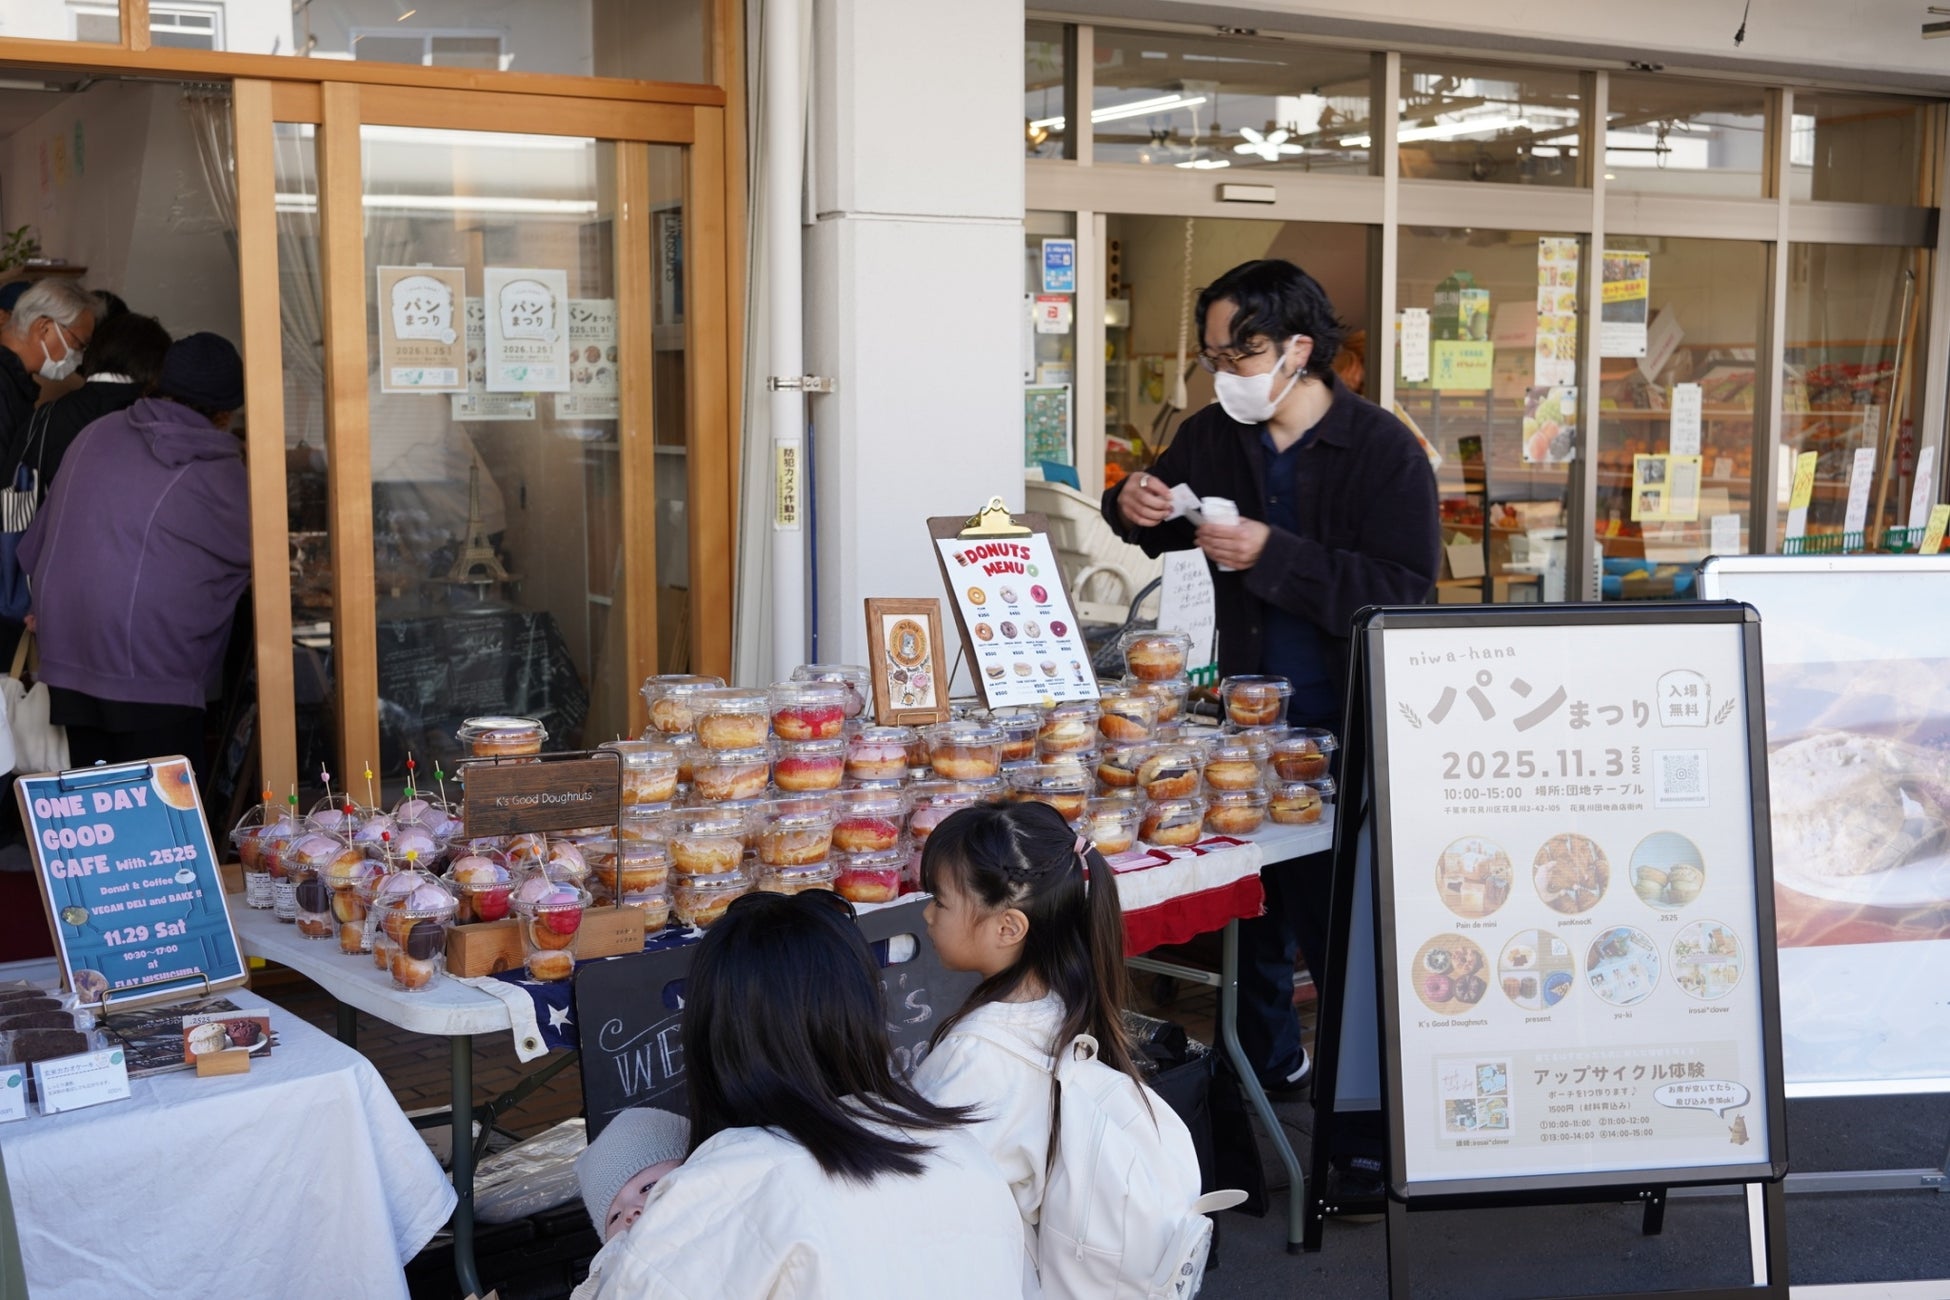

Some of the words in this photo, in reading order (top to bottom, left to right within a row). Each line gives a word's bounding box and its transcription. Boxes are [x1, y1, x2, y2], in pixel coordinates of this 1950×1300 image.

[404, 298, 441, 313] パン
[511, 301, 544, 314] パン
[405, 315, 440, 326] まつり
[512, 316, 543, 327] まつり
[784, 448, 795, 523] 防犯カメラ作動中
[964, 543, 1031, 565] DONUTS
[982, 561, 1025, 577] MENU
[1668, 684, 1699, 698] 入場
[1427, 669, 1650, 733] パンまつり
[1668, 703, 1700, 718] 無料
[1442, 748, 1625, 780] 2025.11.3
[1632, 745, 1641, 775] MON
[496, 796, 509, 808] K's
[512, 793, 539, 806] Good
[542, 791, 593, 806] Doughnuts
[1443, 786, 1523, 800] 10:00-15:00
[35, 795, 86, 818] ONE
[92, 786, 147, 814] DAY
[43, 823, 115, 850] GOOD
[50, 854, 111, 879] CAFE
[148, 845, 197, 867] .2525
[100, 883, 130, 895] Donut
[133, 882, 140, 890] &
[142, 878, 173, 889] Coffee
[91, 903, 124, 915] VEGAN
[126, 899, 147, 909] DELI
[149, 897, 167, 906] and
[168, 892, 193, 903] BAKE
[103, 926, 150, 946] 11.29
[155, 919, 187, 939] Sat
[1472, 921, 1481, 929] de
[147, 959, 159, 969] at
[1431, 1020, 1450, 1028] Good
[1534, 1061, 1706, 1086] アップサイクル体験
